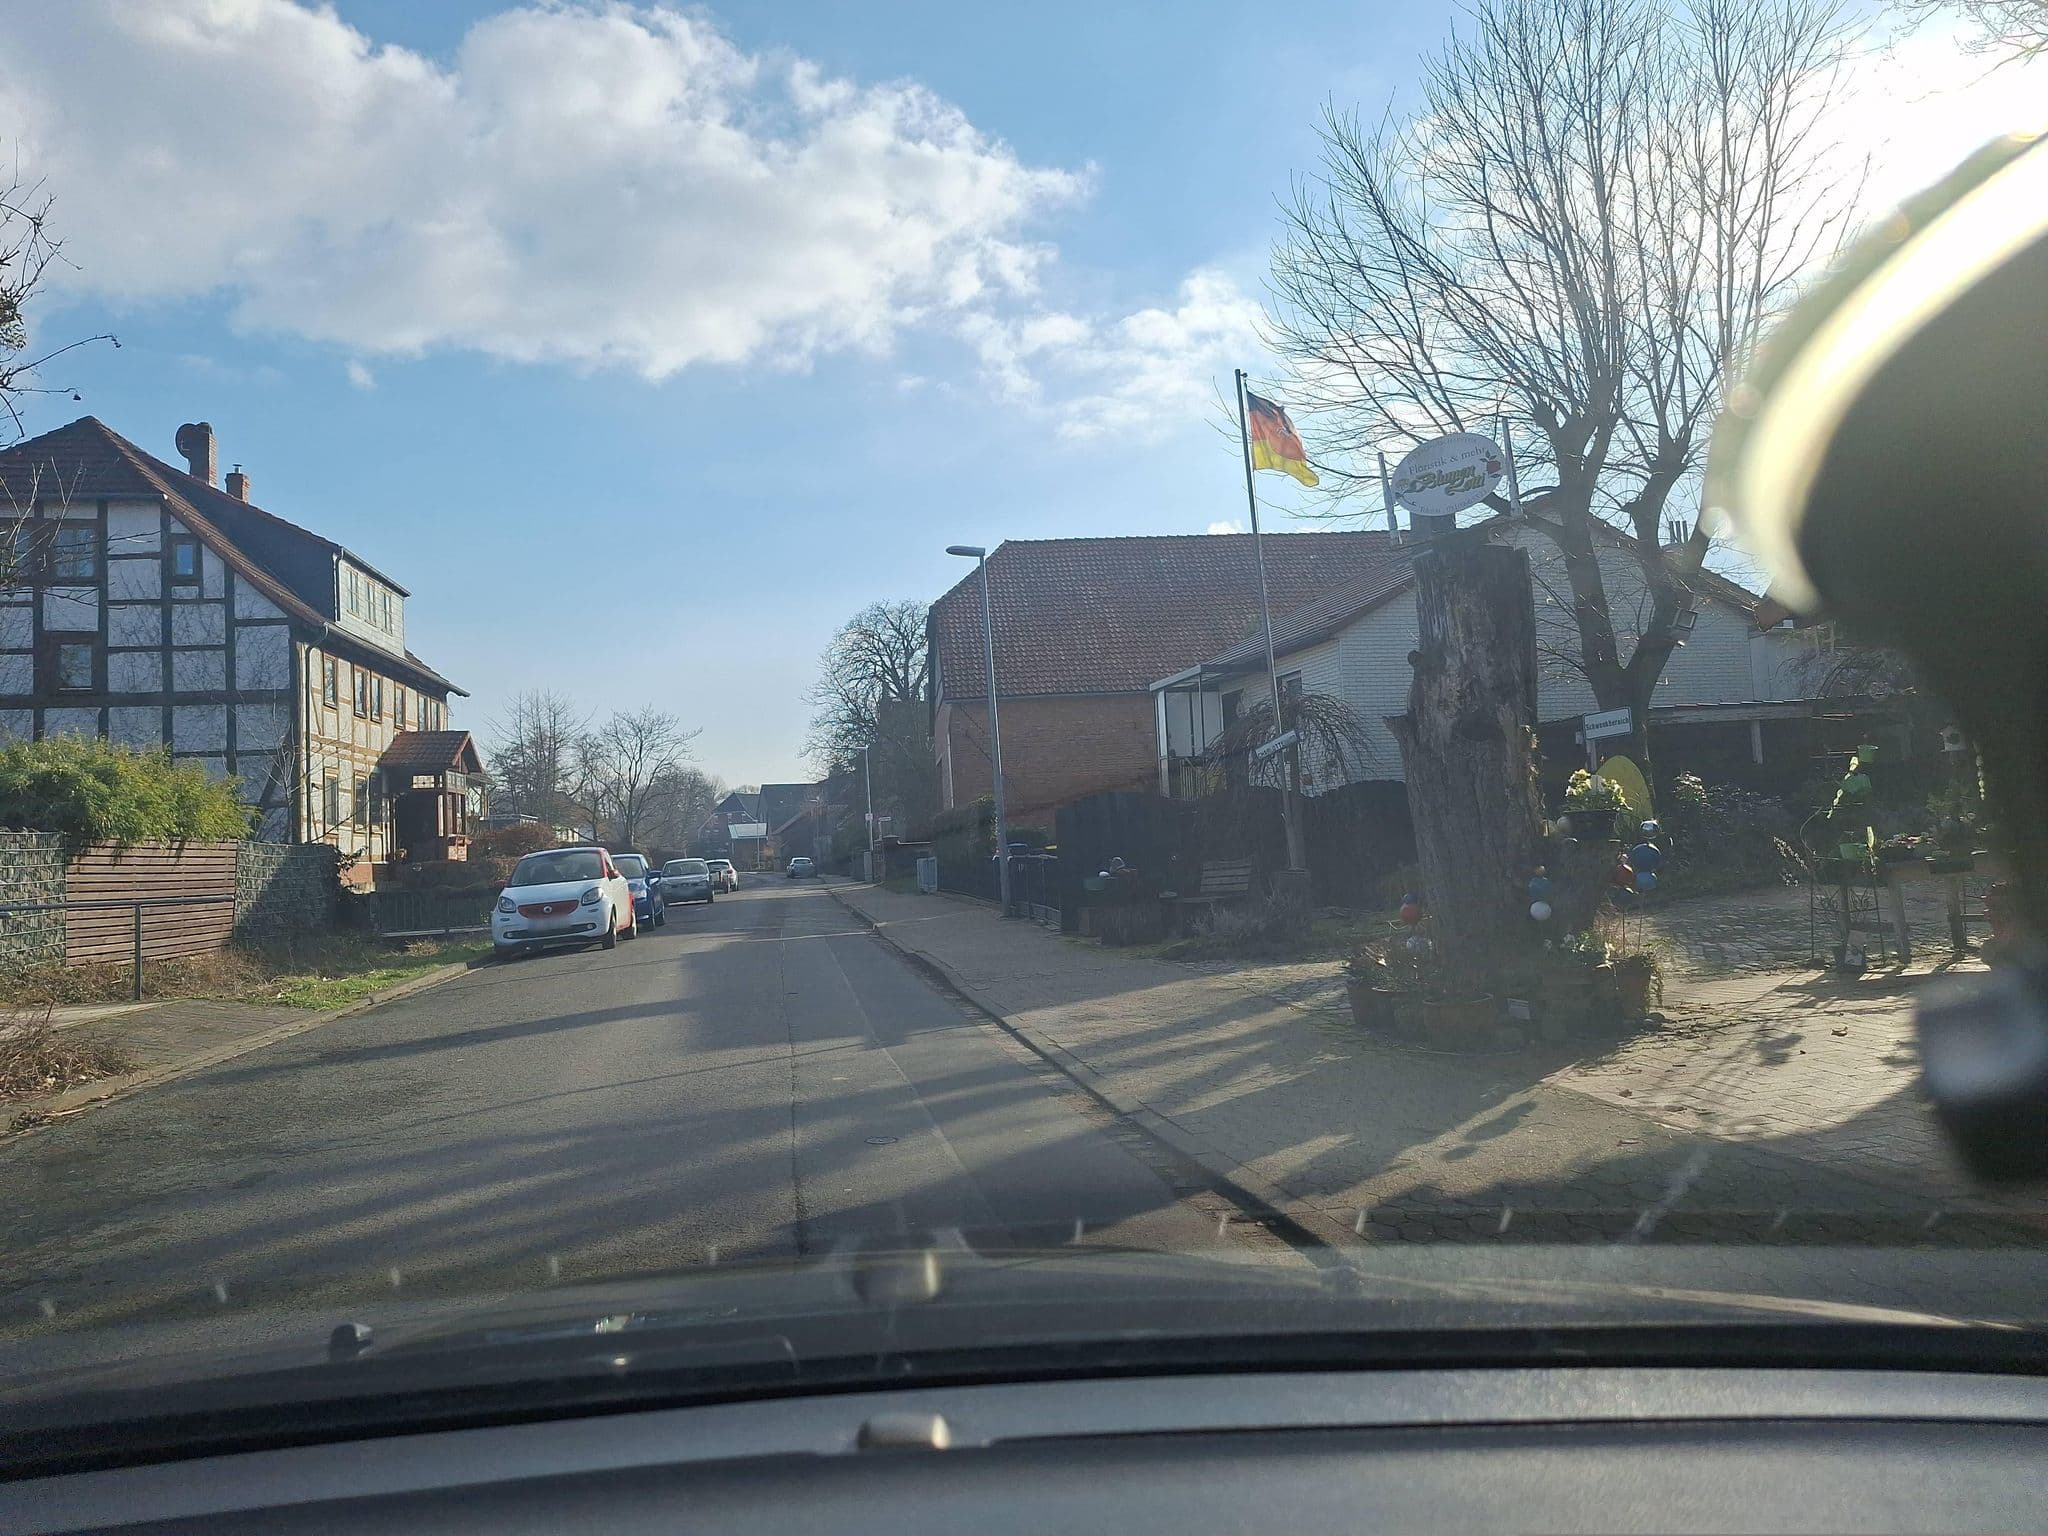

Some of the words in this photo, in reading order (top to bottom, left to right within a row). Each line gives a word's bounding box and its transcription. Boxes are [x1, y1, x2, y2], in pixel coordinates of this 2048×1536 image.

[1409, 457, 1448, 475] Floristik
[1450, 455, 1459, 463] &
[1461, 446, 1486, 461] mehr
